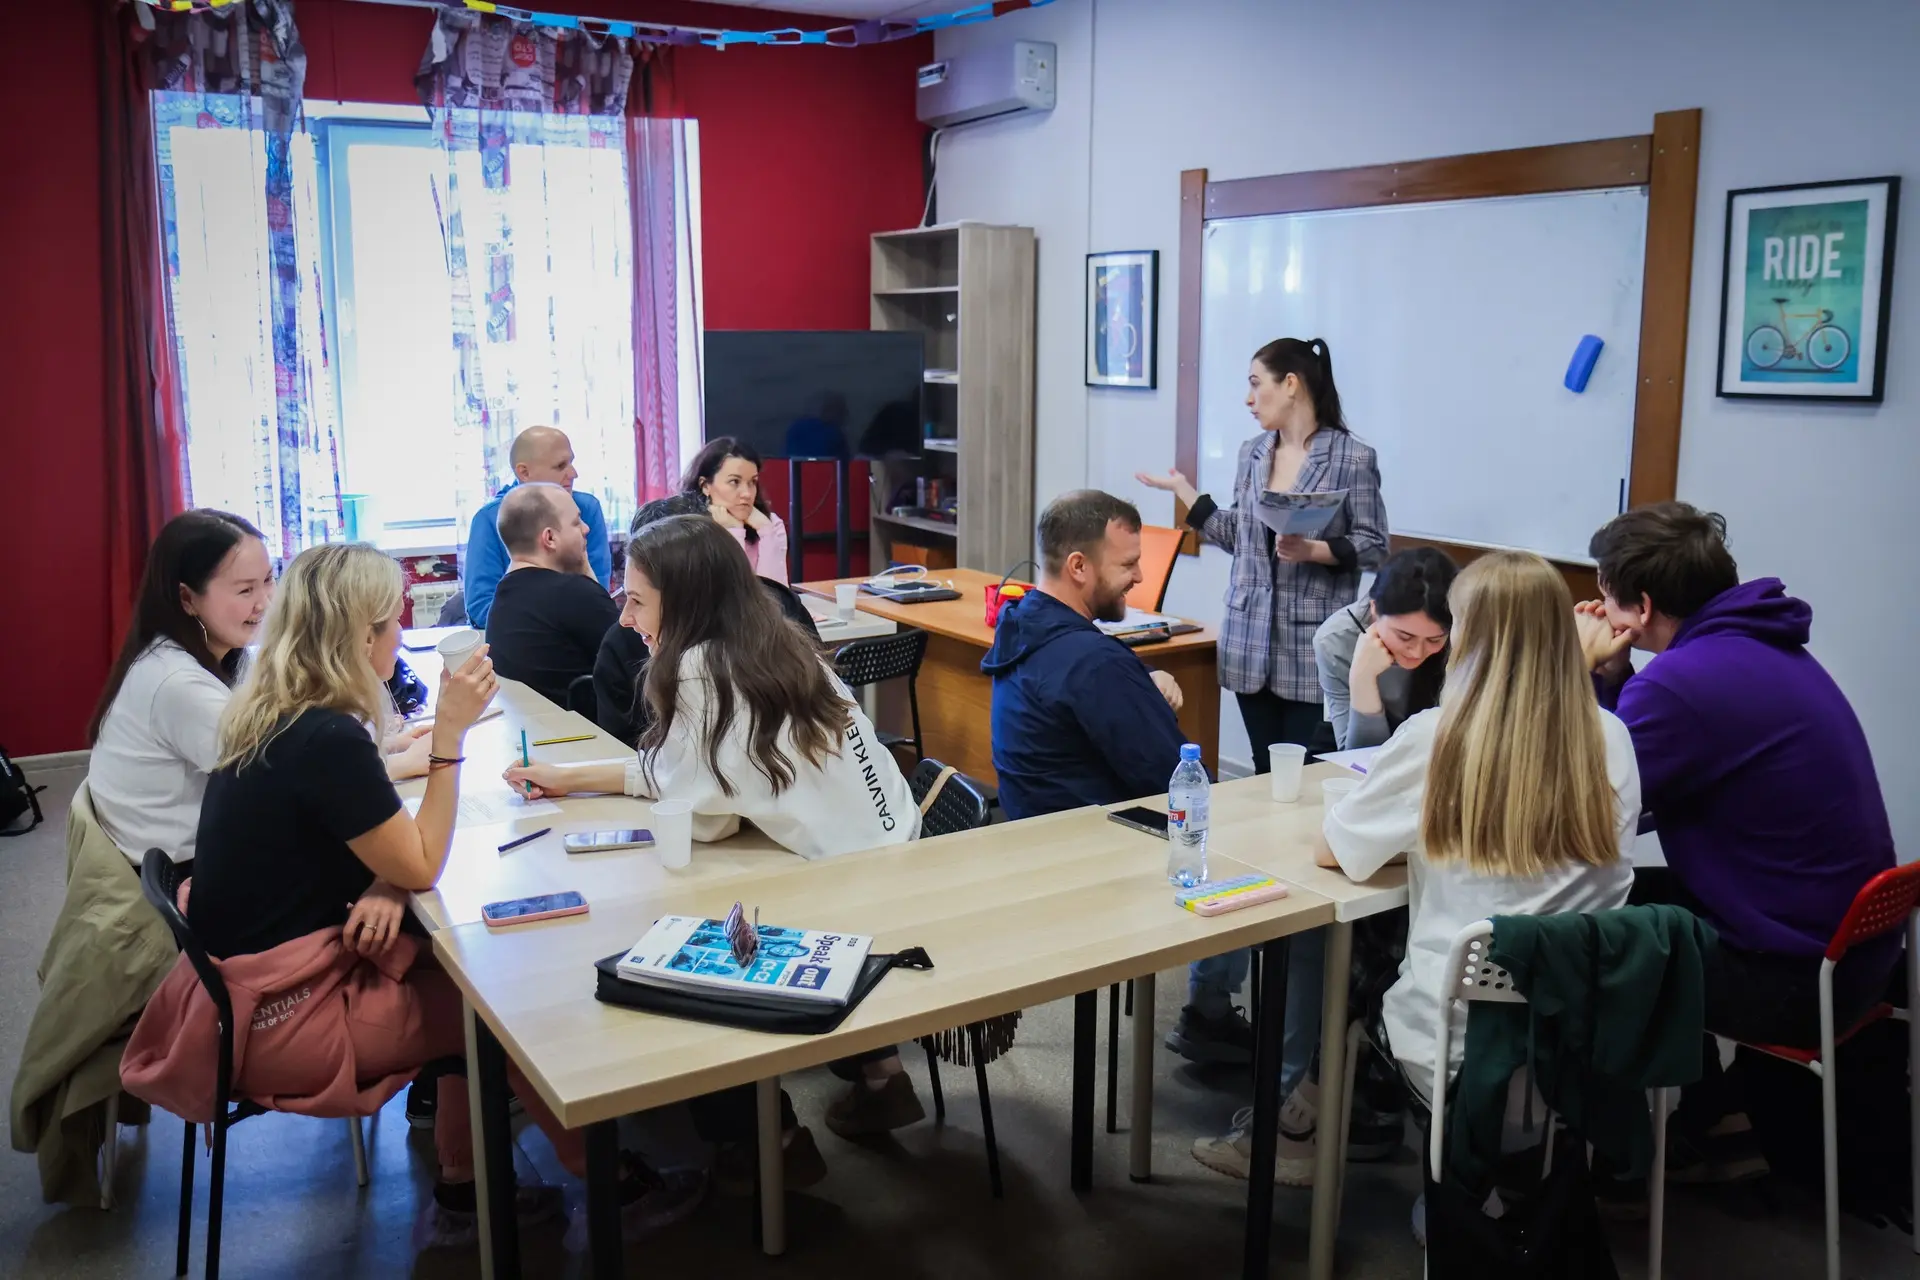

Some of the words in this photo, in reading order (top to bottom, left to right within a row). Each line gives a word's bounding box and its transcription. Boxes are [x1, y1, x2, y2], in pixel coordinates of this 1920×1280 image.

[1763, 232, 1844, 280] RIDE
[844, 717, 869, 764] KLEI
[862, 764, 896, 832] CALVIN
[809, 934, 841, 964] Speak
[268, 1016, 278, 1026] OF
